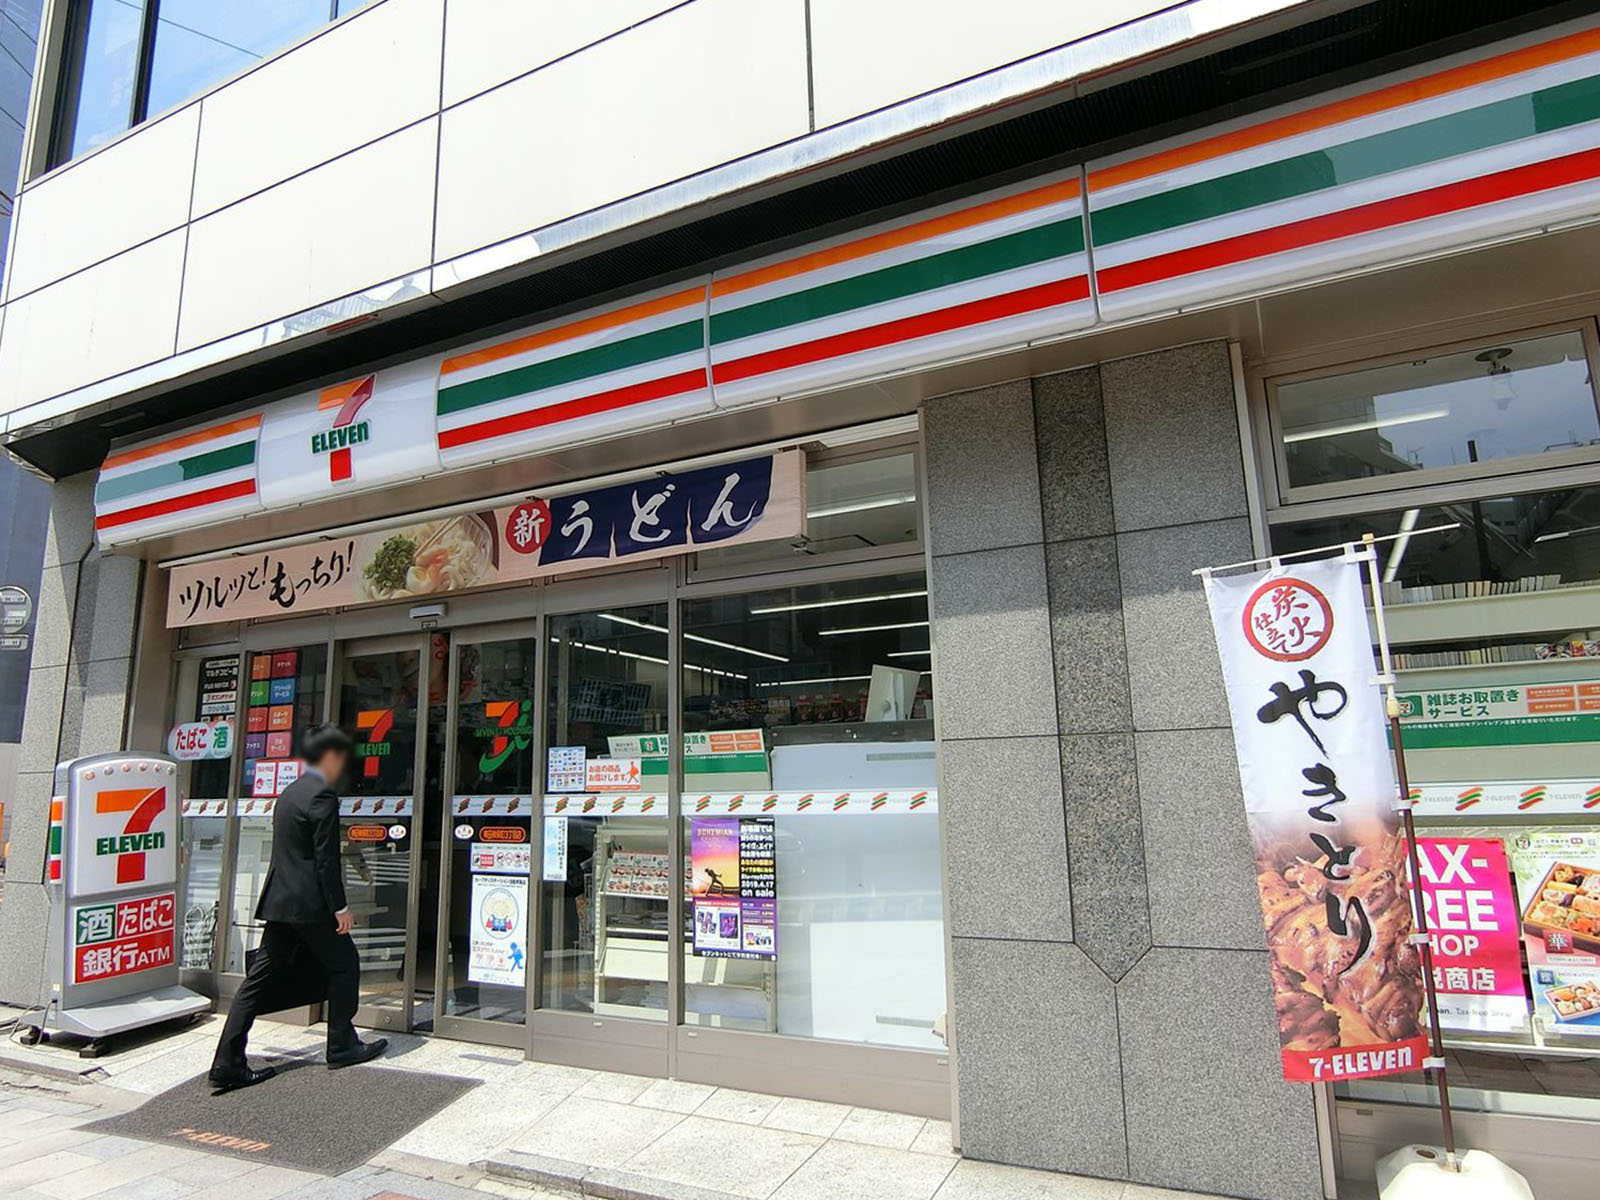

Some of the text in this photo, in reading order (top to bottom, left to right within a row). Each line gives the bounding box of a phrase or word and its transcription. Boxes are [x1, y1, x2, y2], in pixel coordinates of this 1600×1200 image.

[312, 421, 370, 455] ELEVEN
[514, 508, 546, 547] 新
[561, 472, 758, 556] うどん
[1426, 688, 1520, 707] 雑誌お取置き
[1427, 705, 1491, 719] サービス
[176, 726, 229, 750] たばこ 酒
[96, 786, 166, 884] 7 ELEVEN
[1256, 669, 1372, 976] やきとり
[741, 888, 775, 897] on sale
[1410, 889, 1499, 931] REE
[78, 899, 173, 944] 酒 たばこ
[1309, 1046, 1413, 1079] 7-ELEVEN
